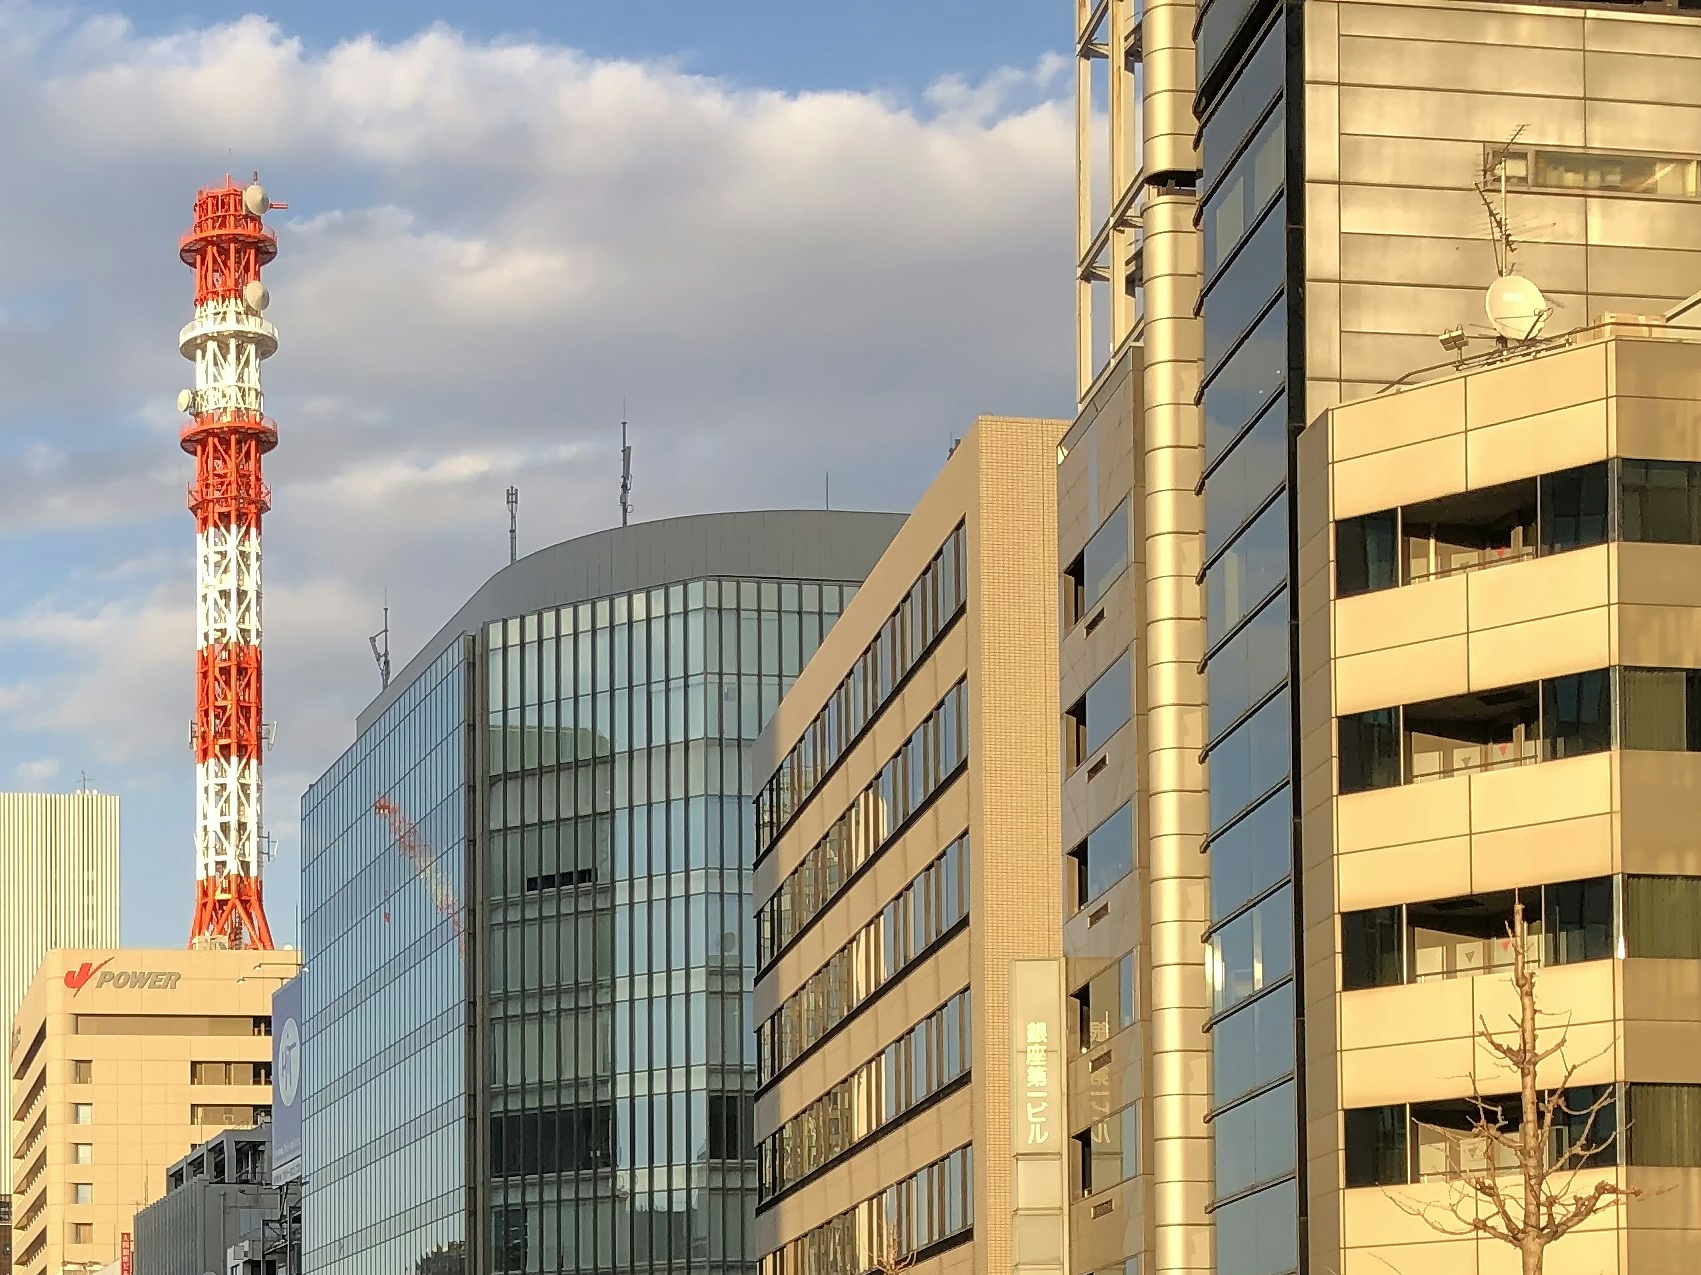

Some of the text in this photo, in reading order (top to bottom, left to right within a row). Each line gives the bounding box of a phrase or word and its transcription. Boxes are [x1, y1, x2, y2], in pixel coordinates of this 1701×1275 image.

[95, 971, 181, 990] POWER
[1026, 1022, 1049, 1144] 銀座第一ビル
